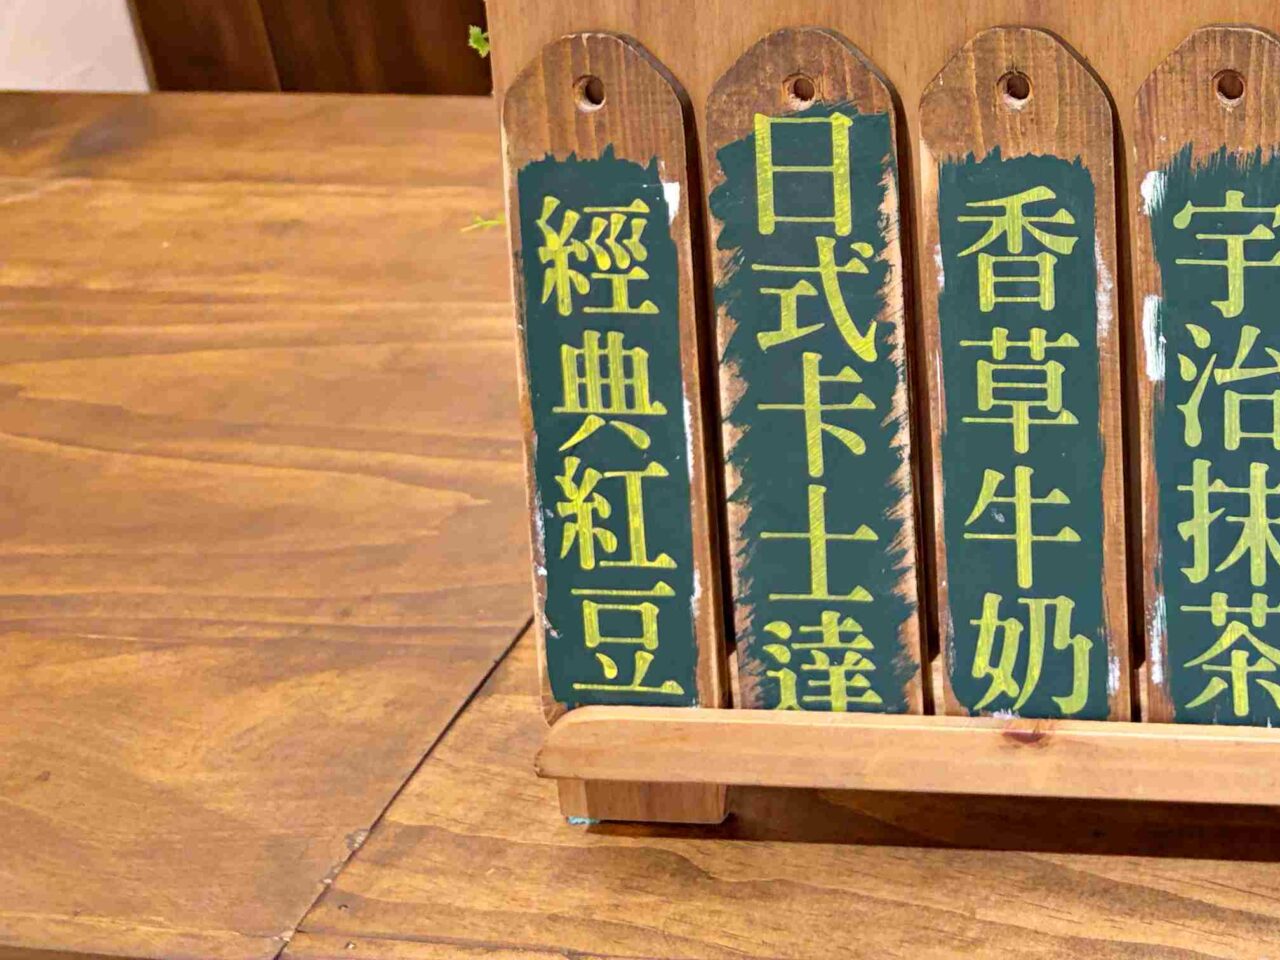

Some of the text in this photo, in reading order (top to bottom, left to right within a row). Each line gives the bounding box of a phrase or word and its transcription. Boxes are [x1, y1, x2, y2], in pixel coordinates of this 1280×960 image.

[536, 195, 685, 696] 經典紅豆
[751, 111, 883, 713] 日式卡士達
[957, 185, 1094, 715] 香草牛奶
